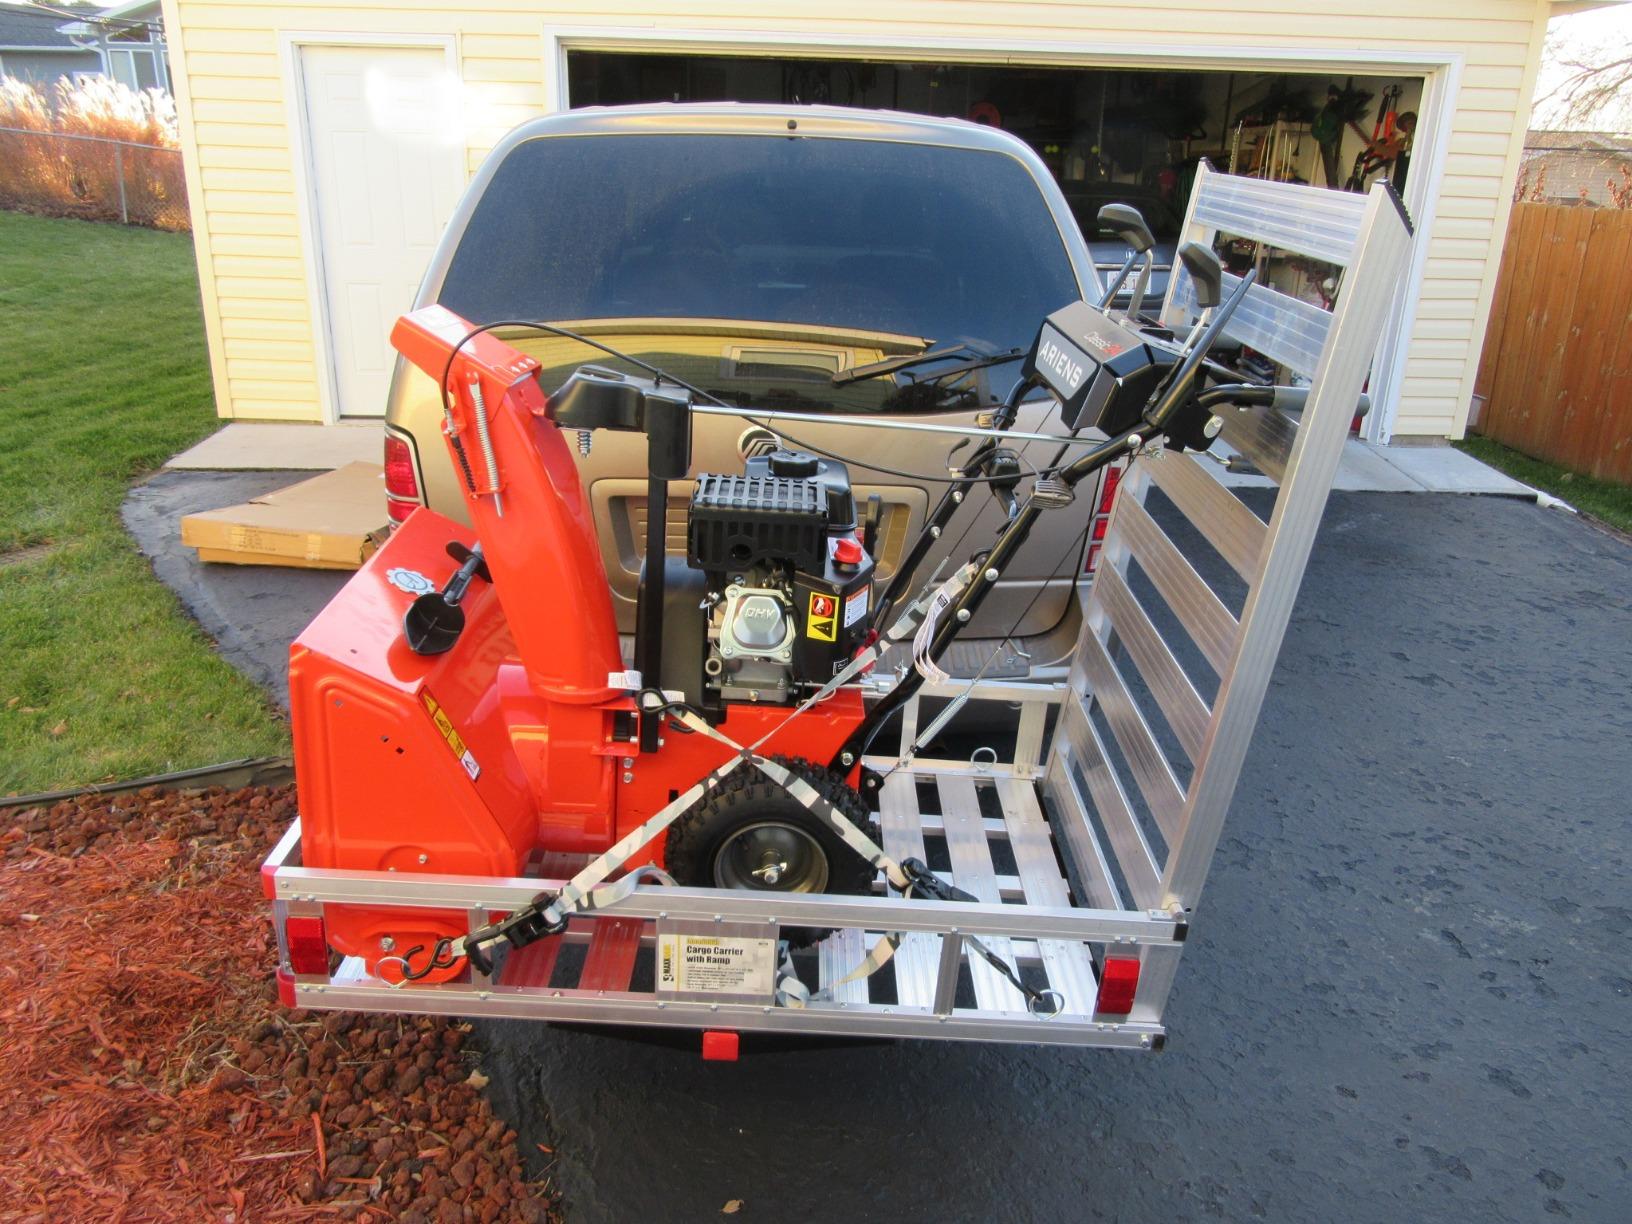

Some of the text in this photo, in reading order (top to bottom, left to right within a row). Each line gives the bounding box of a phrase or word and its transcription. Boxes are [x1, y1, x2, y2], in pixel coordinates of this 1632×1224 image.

[1039, 341, 1083, 388] ARIENS
[686, 945, 744, 956] Cargo Carrier
[686, 955, 731, 965] with Ramp
